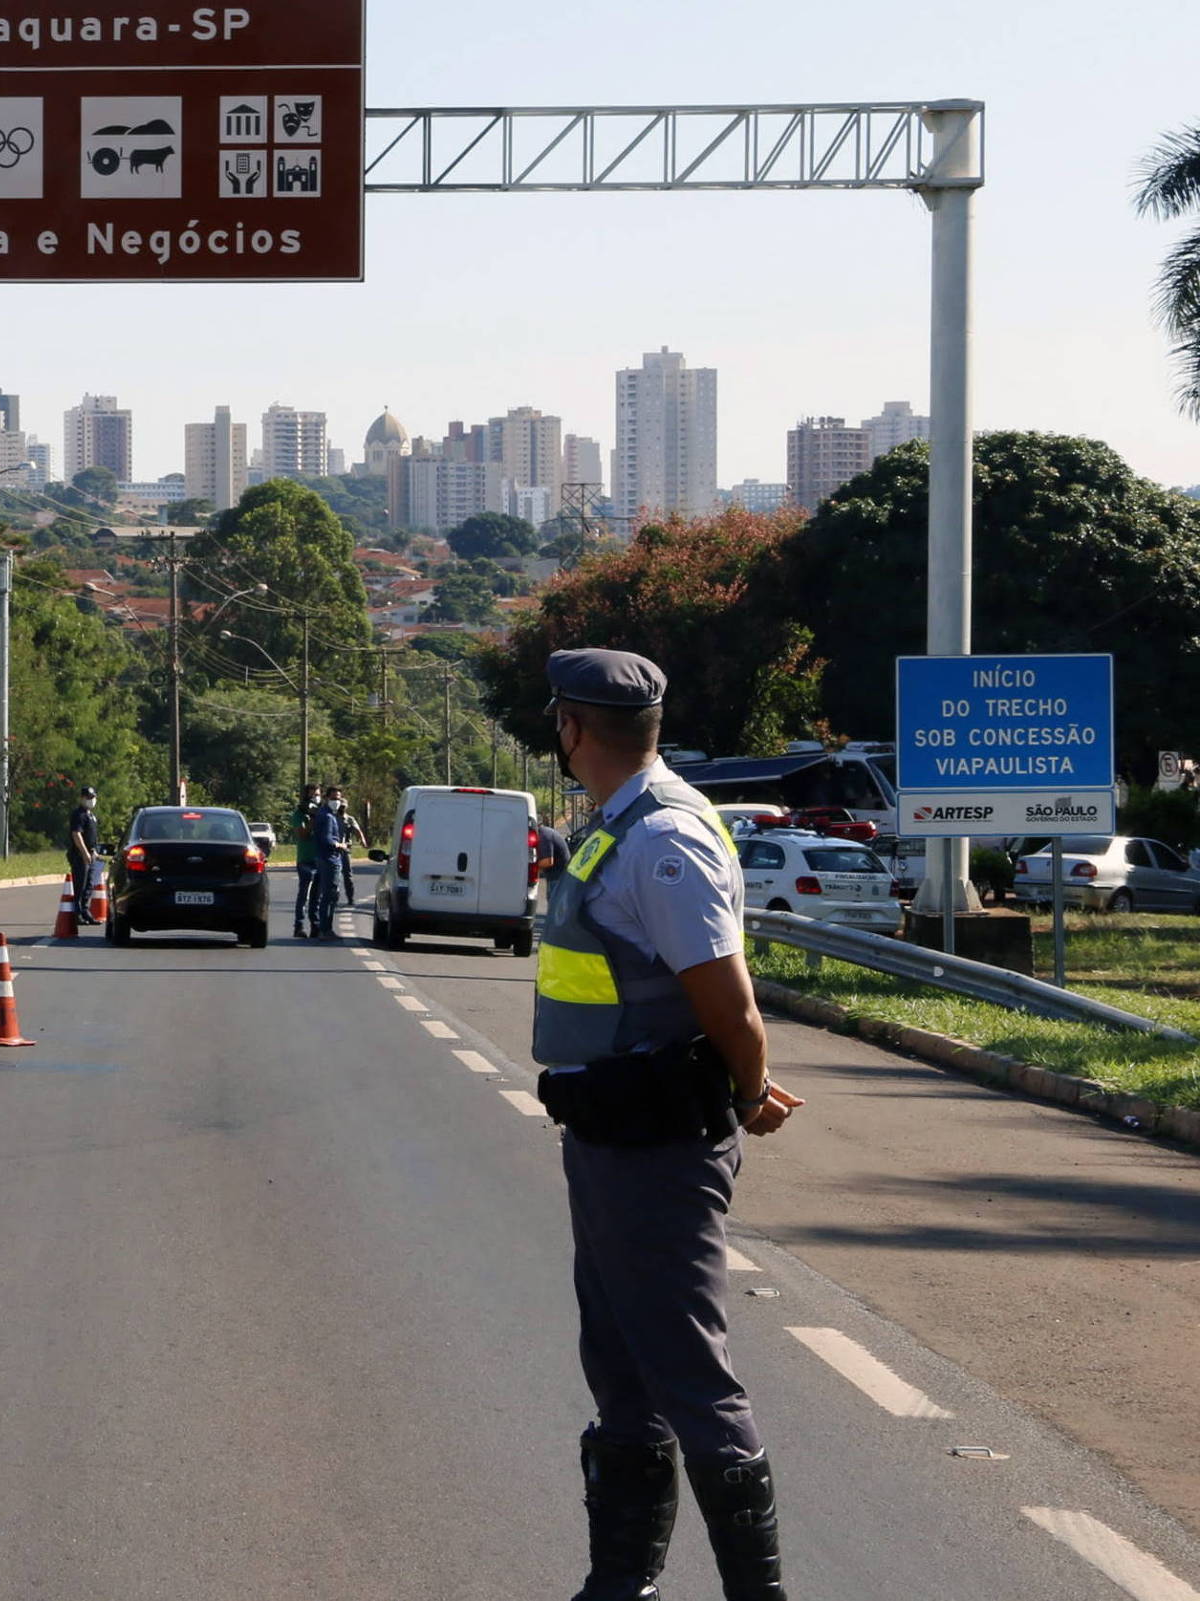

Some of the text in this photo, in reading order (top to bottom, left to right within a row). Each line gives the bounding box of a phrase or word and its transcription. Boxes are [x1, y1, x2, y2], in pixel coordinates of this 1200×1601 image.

[37, 231, 59, 255] e
[86, 219, 303, 265] Negócios
[973, 664, 1035, 688] INÍCIO
[942, 699, 1068, 717] DO TRECHO
[914, 724, 1096, 747] SOB CONCESSÃO
[936, 757, 1074, 775] VIAPAULISTA
[933, 807, 994, 820] ARTESP
[1026, 804, 1098, 817] SÃO PAULO
